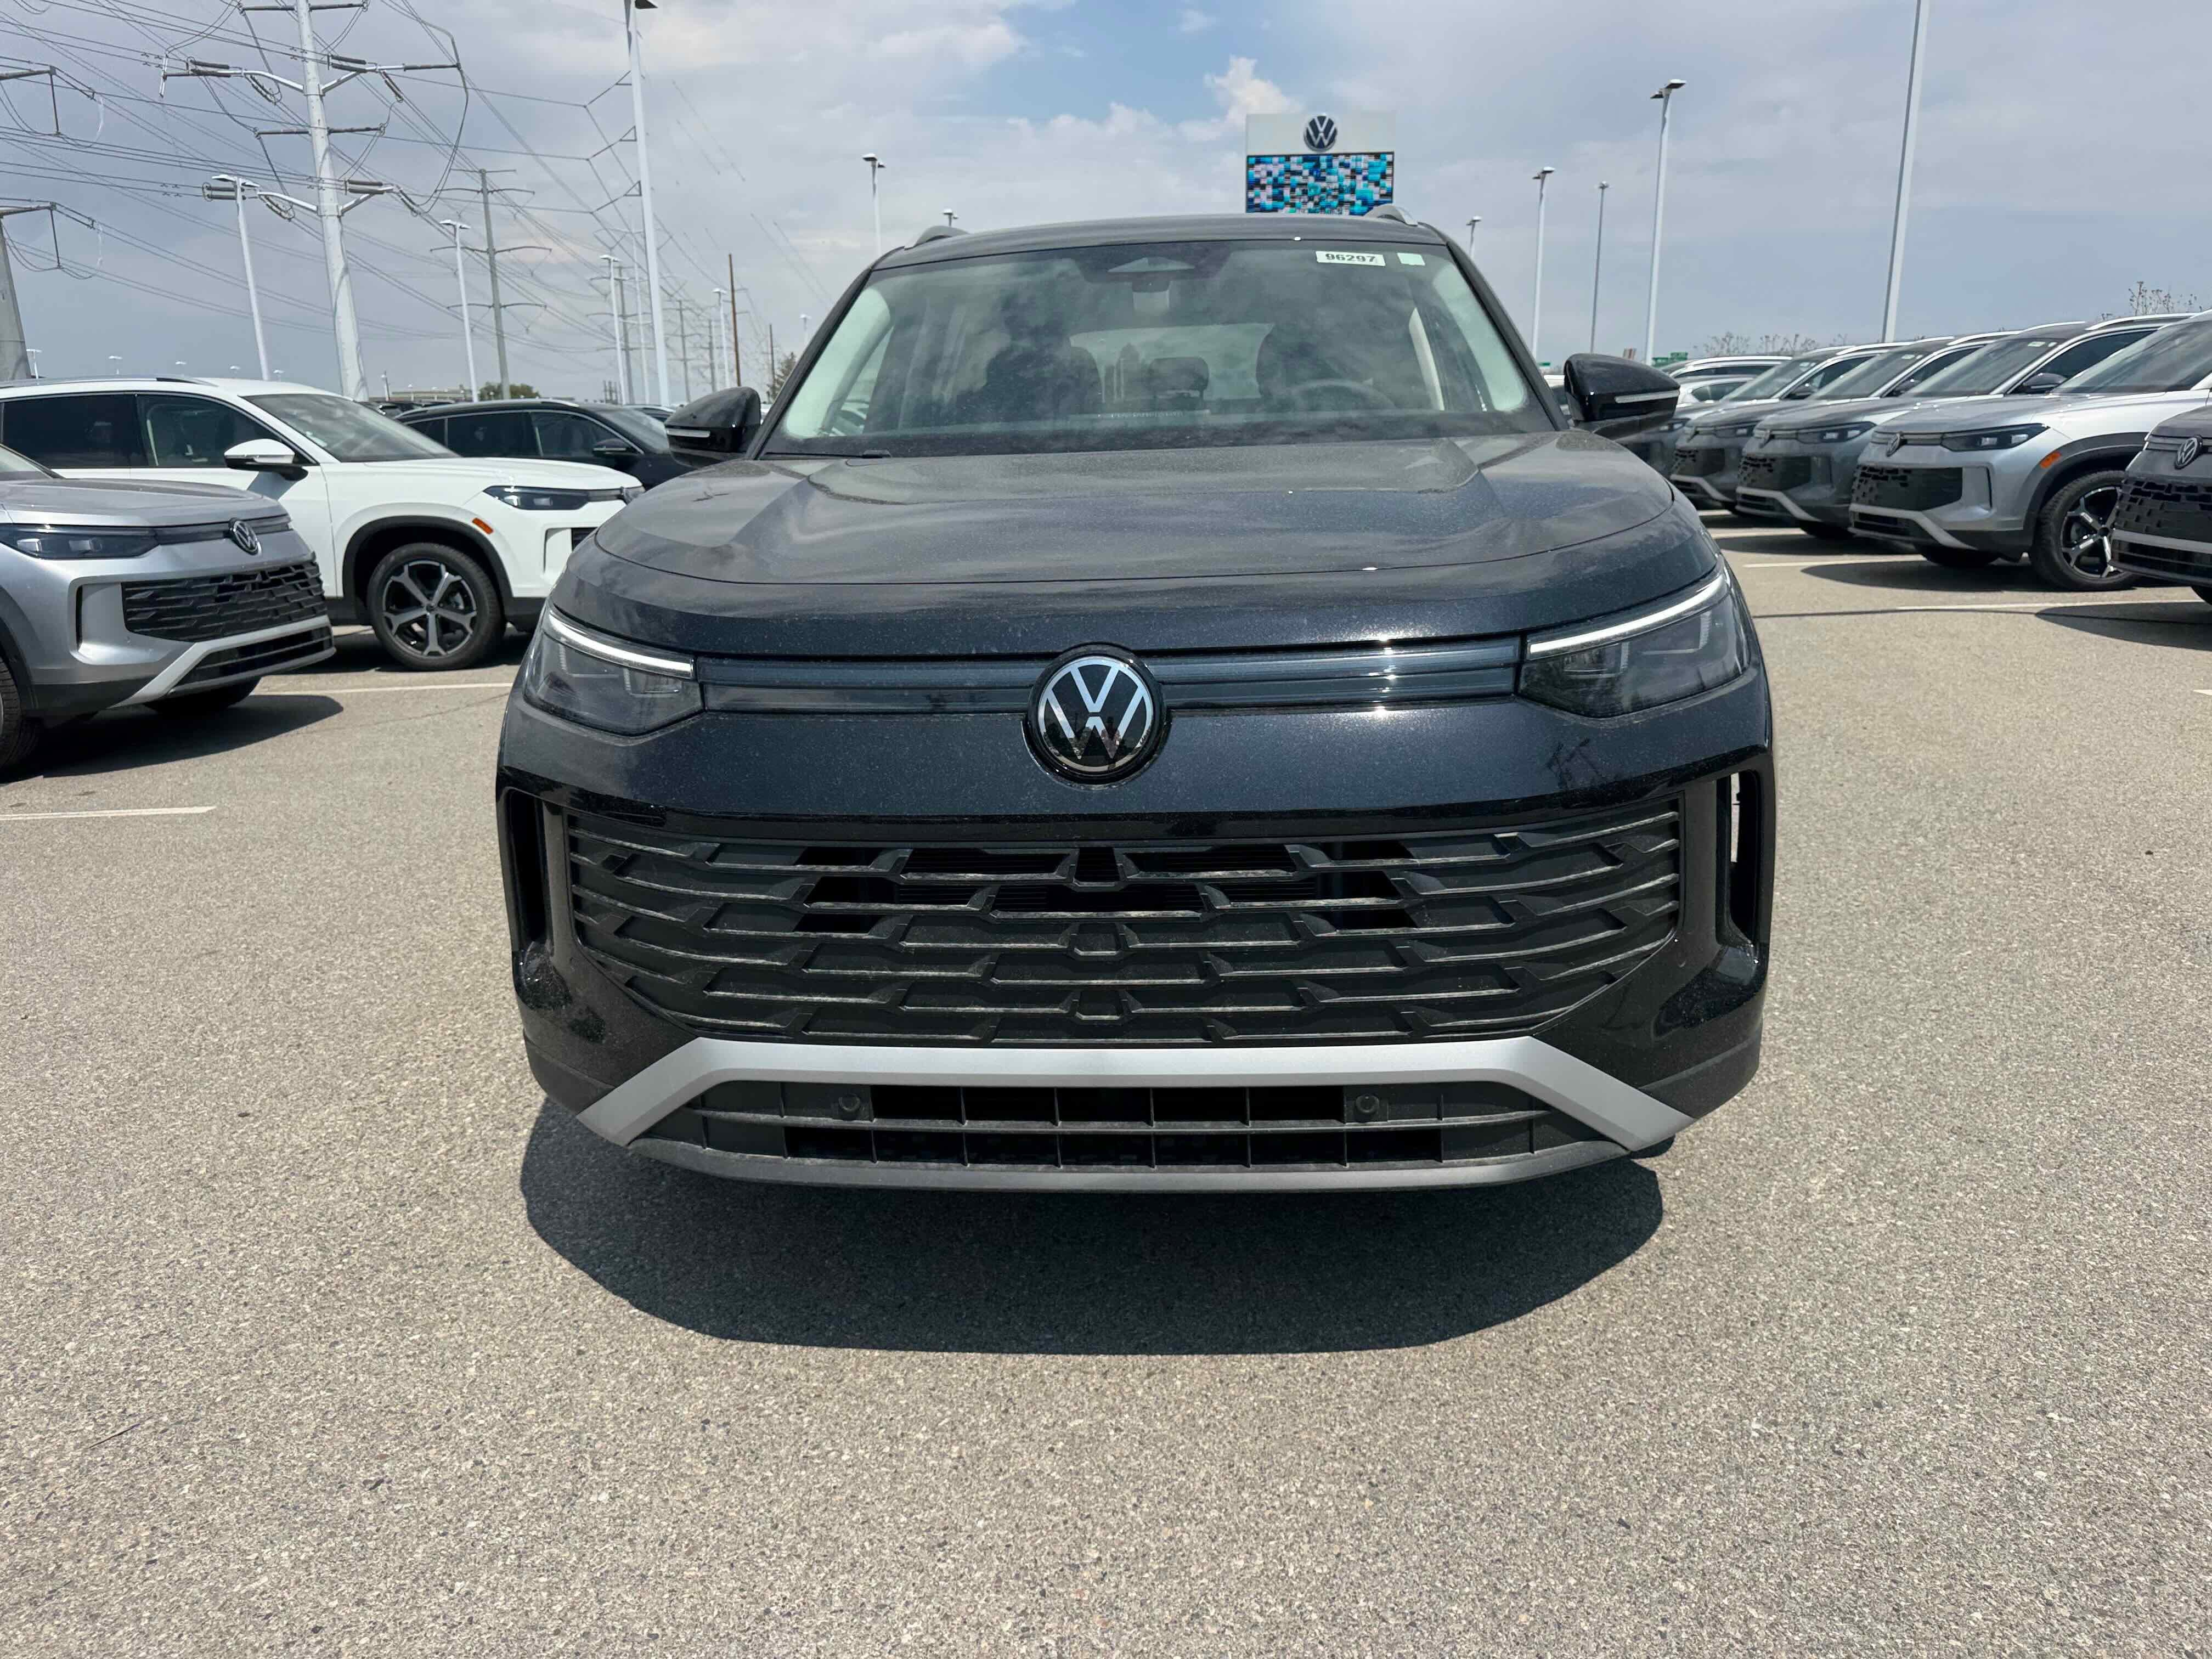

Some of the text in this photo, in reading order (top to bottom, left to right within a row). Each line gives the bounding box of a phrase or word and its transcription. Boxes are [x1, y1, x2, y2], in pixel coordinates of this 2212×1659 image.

[1306, 114, 1335, 148] VW
[1325, 253, 1375, 262] 96297
[2177, 439, 2196, 464] VW
[234, 522, 256, 550] VW
[1043, 661, 1147, 763] VW
